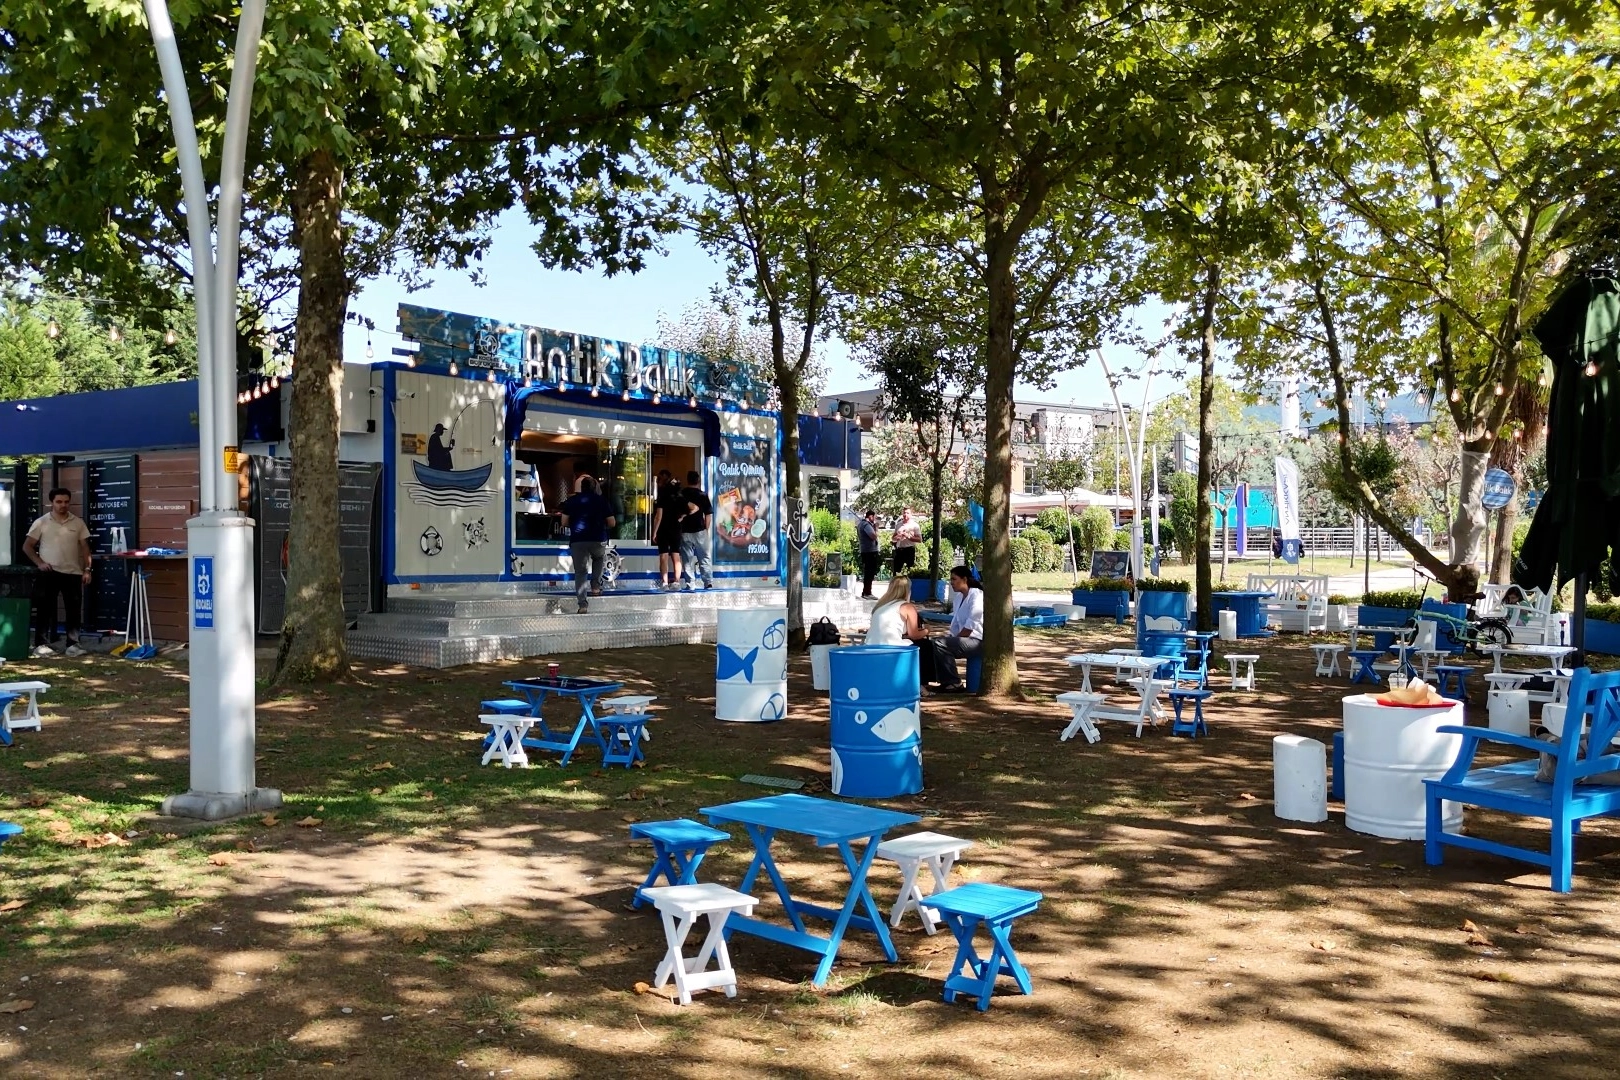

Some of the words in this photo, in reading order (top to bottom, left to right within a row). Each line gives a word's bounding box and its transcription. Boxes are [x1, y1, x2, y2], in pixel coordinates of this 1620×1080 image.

[522, 327, 615, 388] Antik
[624, 342, 699, 398] Balık
[719, 462, 740, 476] Balık
[1495, 484, 1512, 495] Balık
